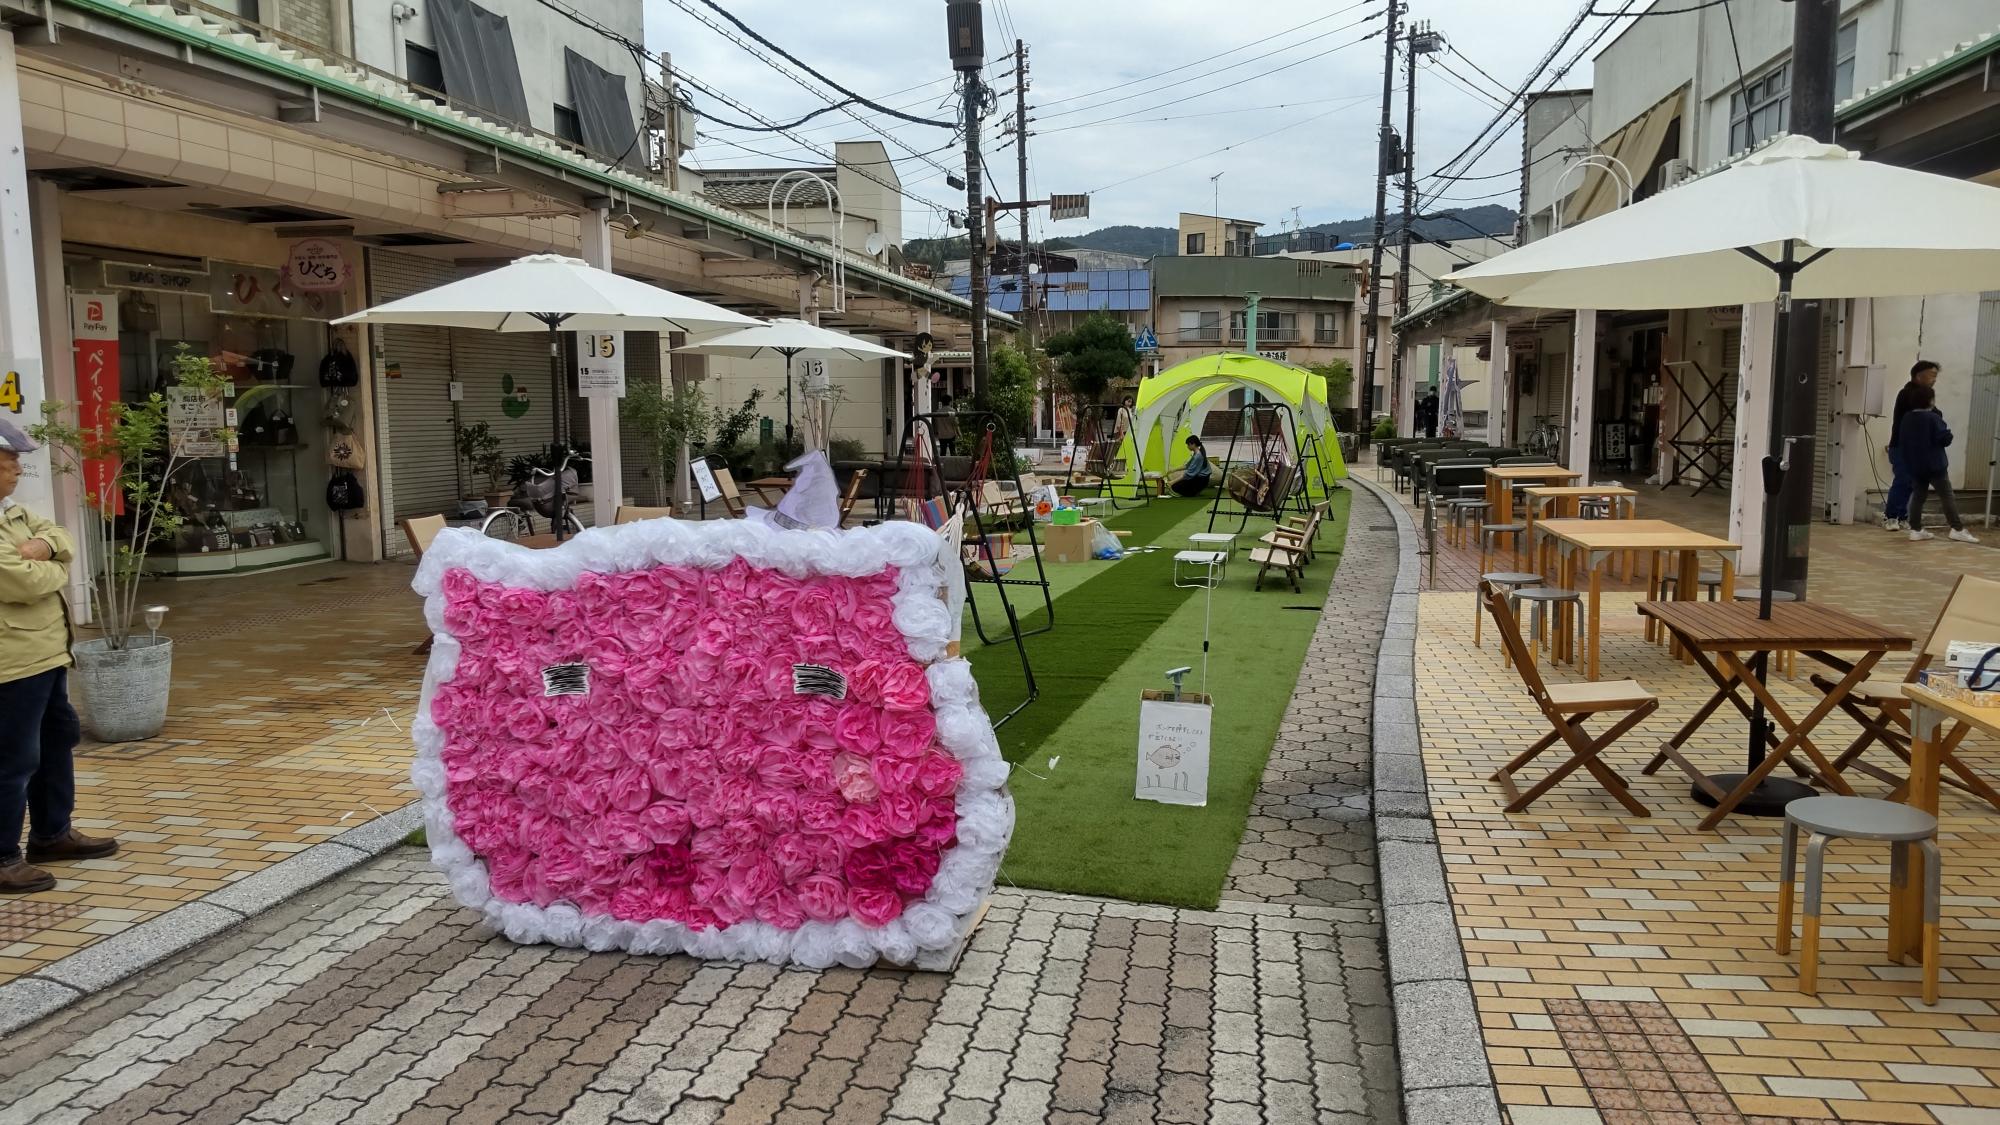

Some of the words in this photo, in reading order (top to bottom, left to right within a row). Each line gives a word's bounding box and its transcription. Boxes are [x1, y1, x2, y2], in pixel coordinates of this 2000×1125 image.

[128, 270, 154, 284] BAG
[160, 274, 192, 288] SHOP
[298, 260, 337, 280] ひぐち
[83, 322, 107, 332] PayPay
[584, 334, 616, 358] 15
[580, 367, 589, 375] 15
[802, 360, 823, 376] 16
[0, 371, 25, 414] 4
